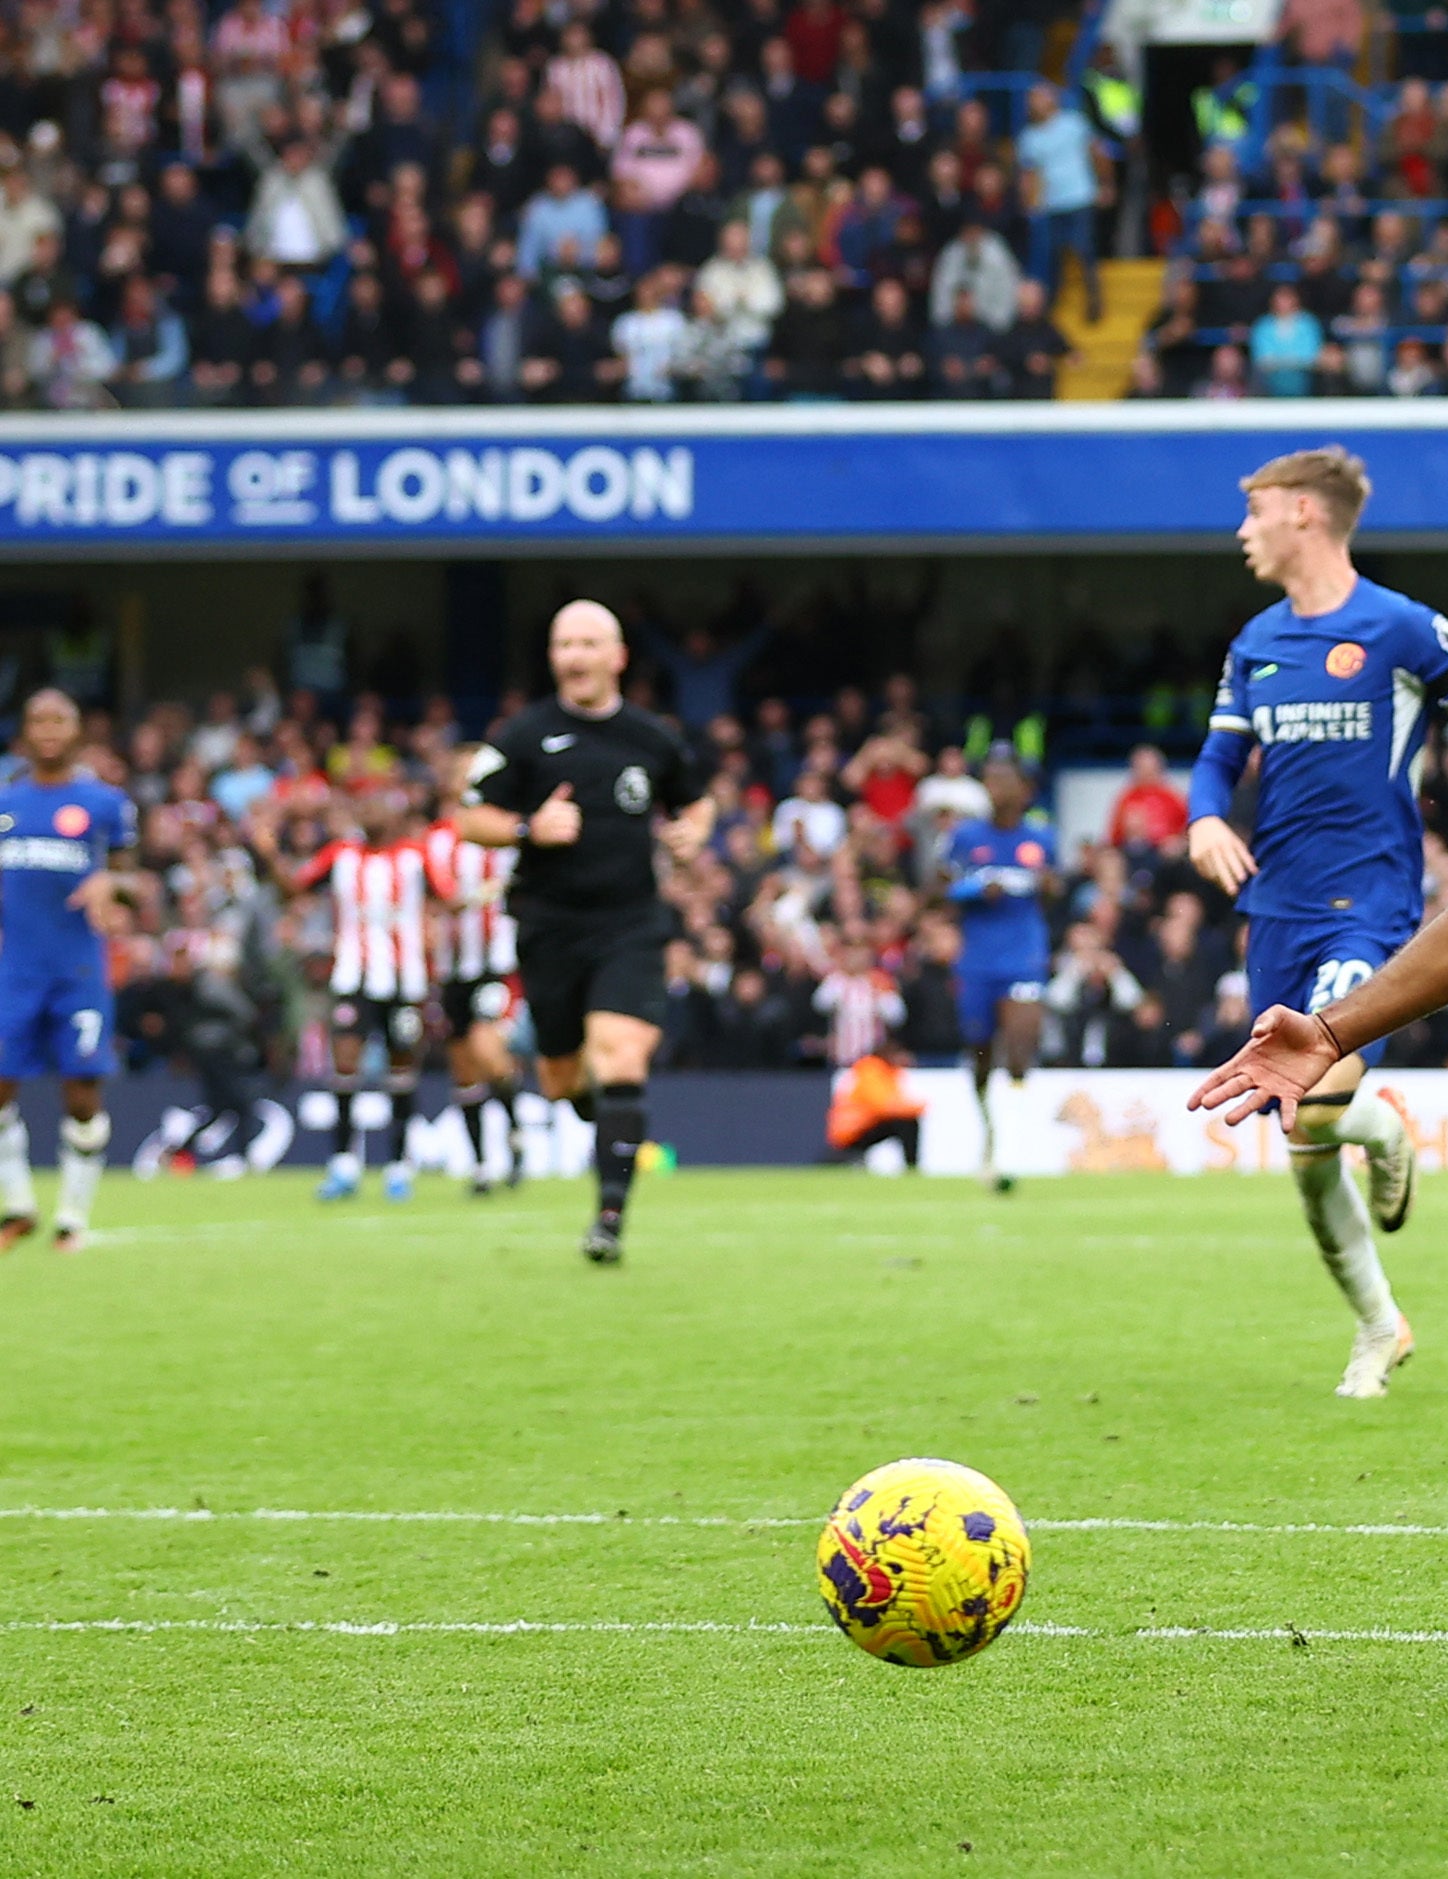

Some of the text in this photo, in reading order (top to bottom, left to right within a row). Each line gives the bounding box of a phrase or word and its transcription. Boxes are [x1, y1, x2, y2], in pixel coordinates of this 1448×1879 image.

[227, 450, 319, 508] OF
[331, 446, 694, 523] LONDON
[1275, 702, 1371, 723] INFINITE
[1309, 959, 1375, 1013] 20
[71, 1008, 103, 1058] 7
